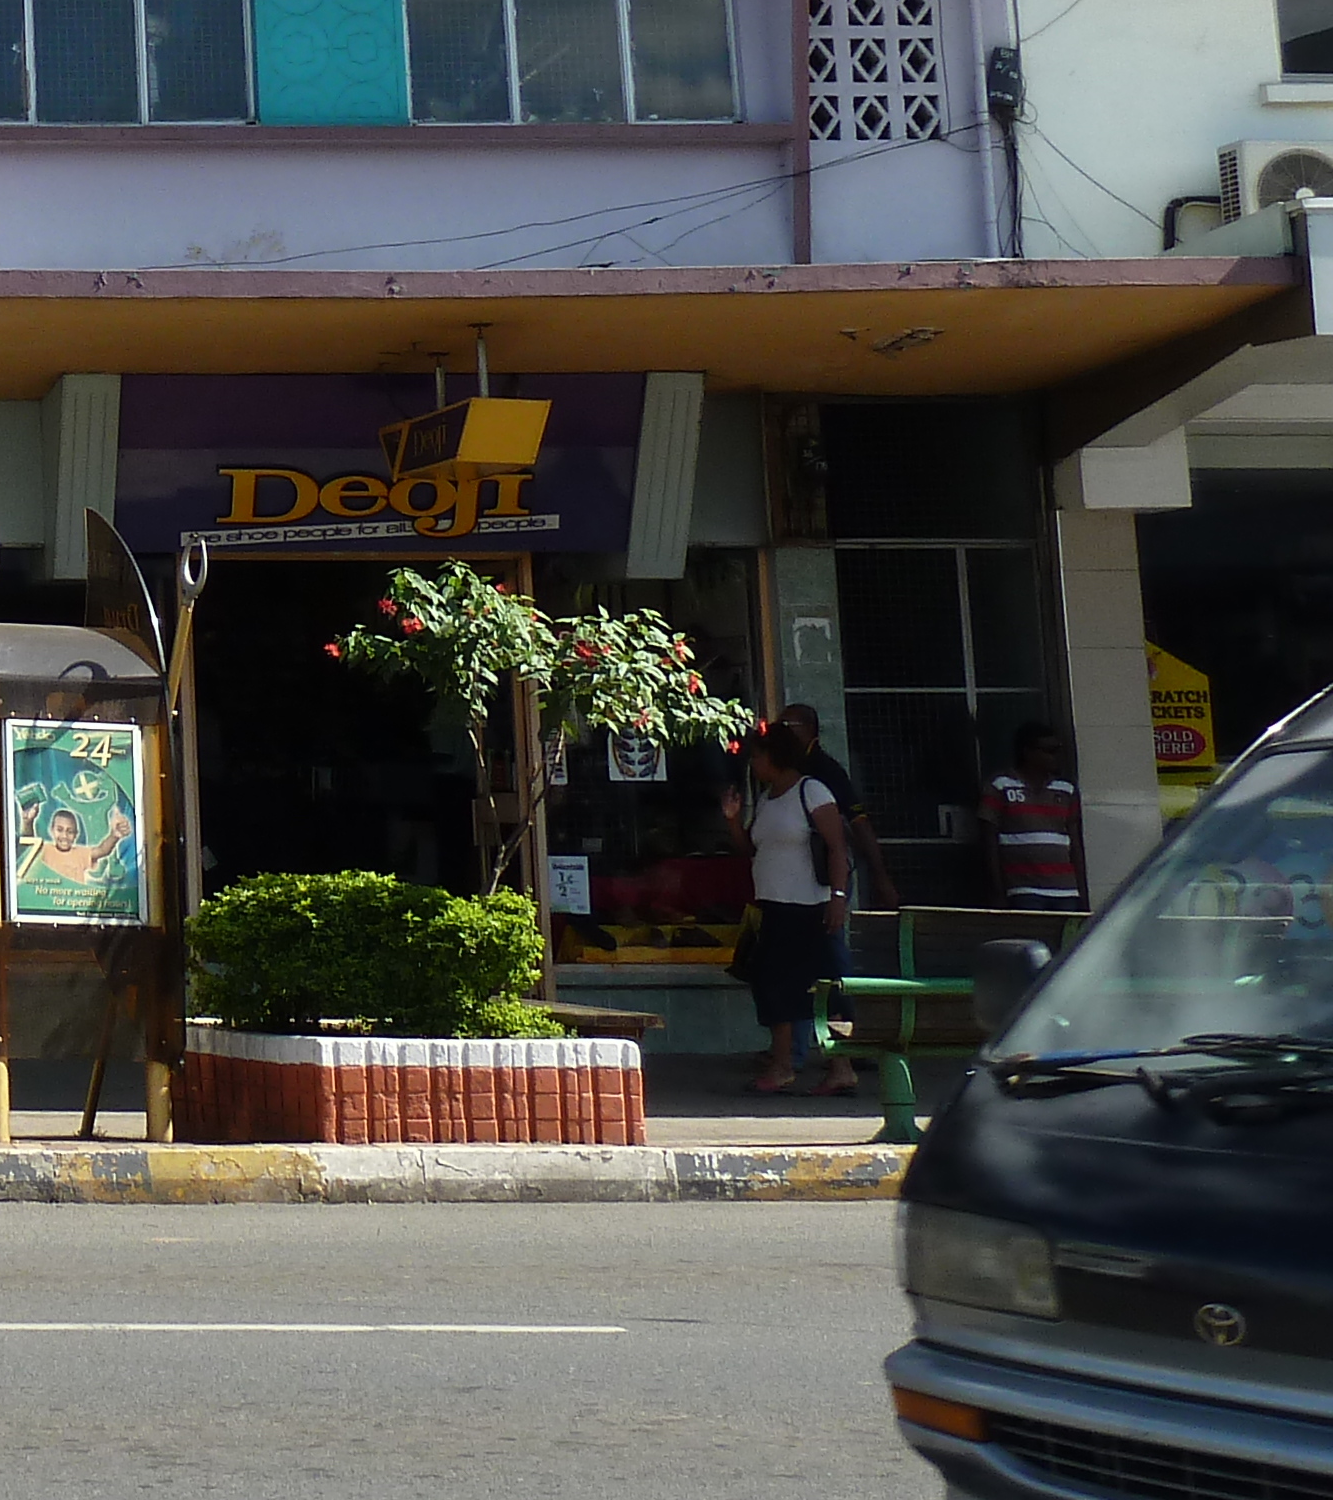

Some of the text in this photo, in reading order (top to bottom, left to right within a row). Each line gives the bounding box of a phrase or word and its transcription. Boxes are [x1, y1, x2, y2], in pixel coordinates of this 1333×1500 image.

[226, 527, 278, 542] shoe
[283, 524, 353, 541] people
[357, 520, 381, 534] for
[69, 733, 112, 767] 24
[1006, 789, 1026, 803] 05
[17, 836, 44, 878] 7
